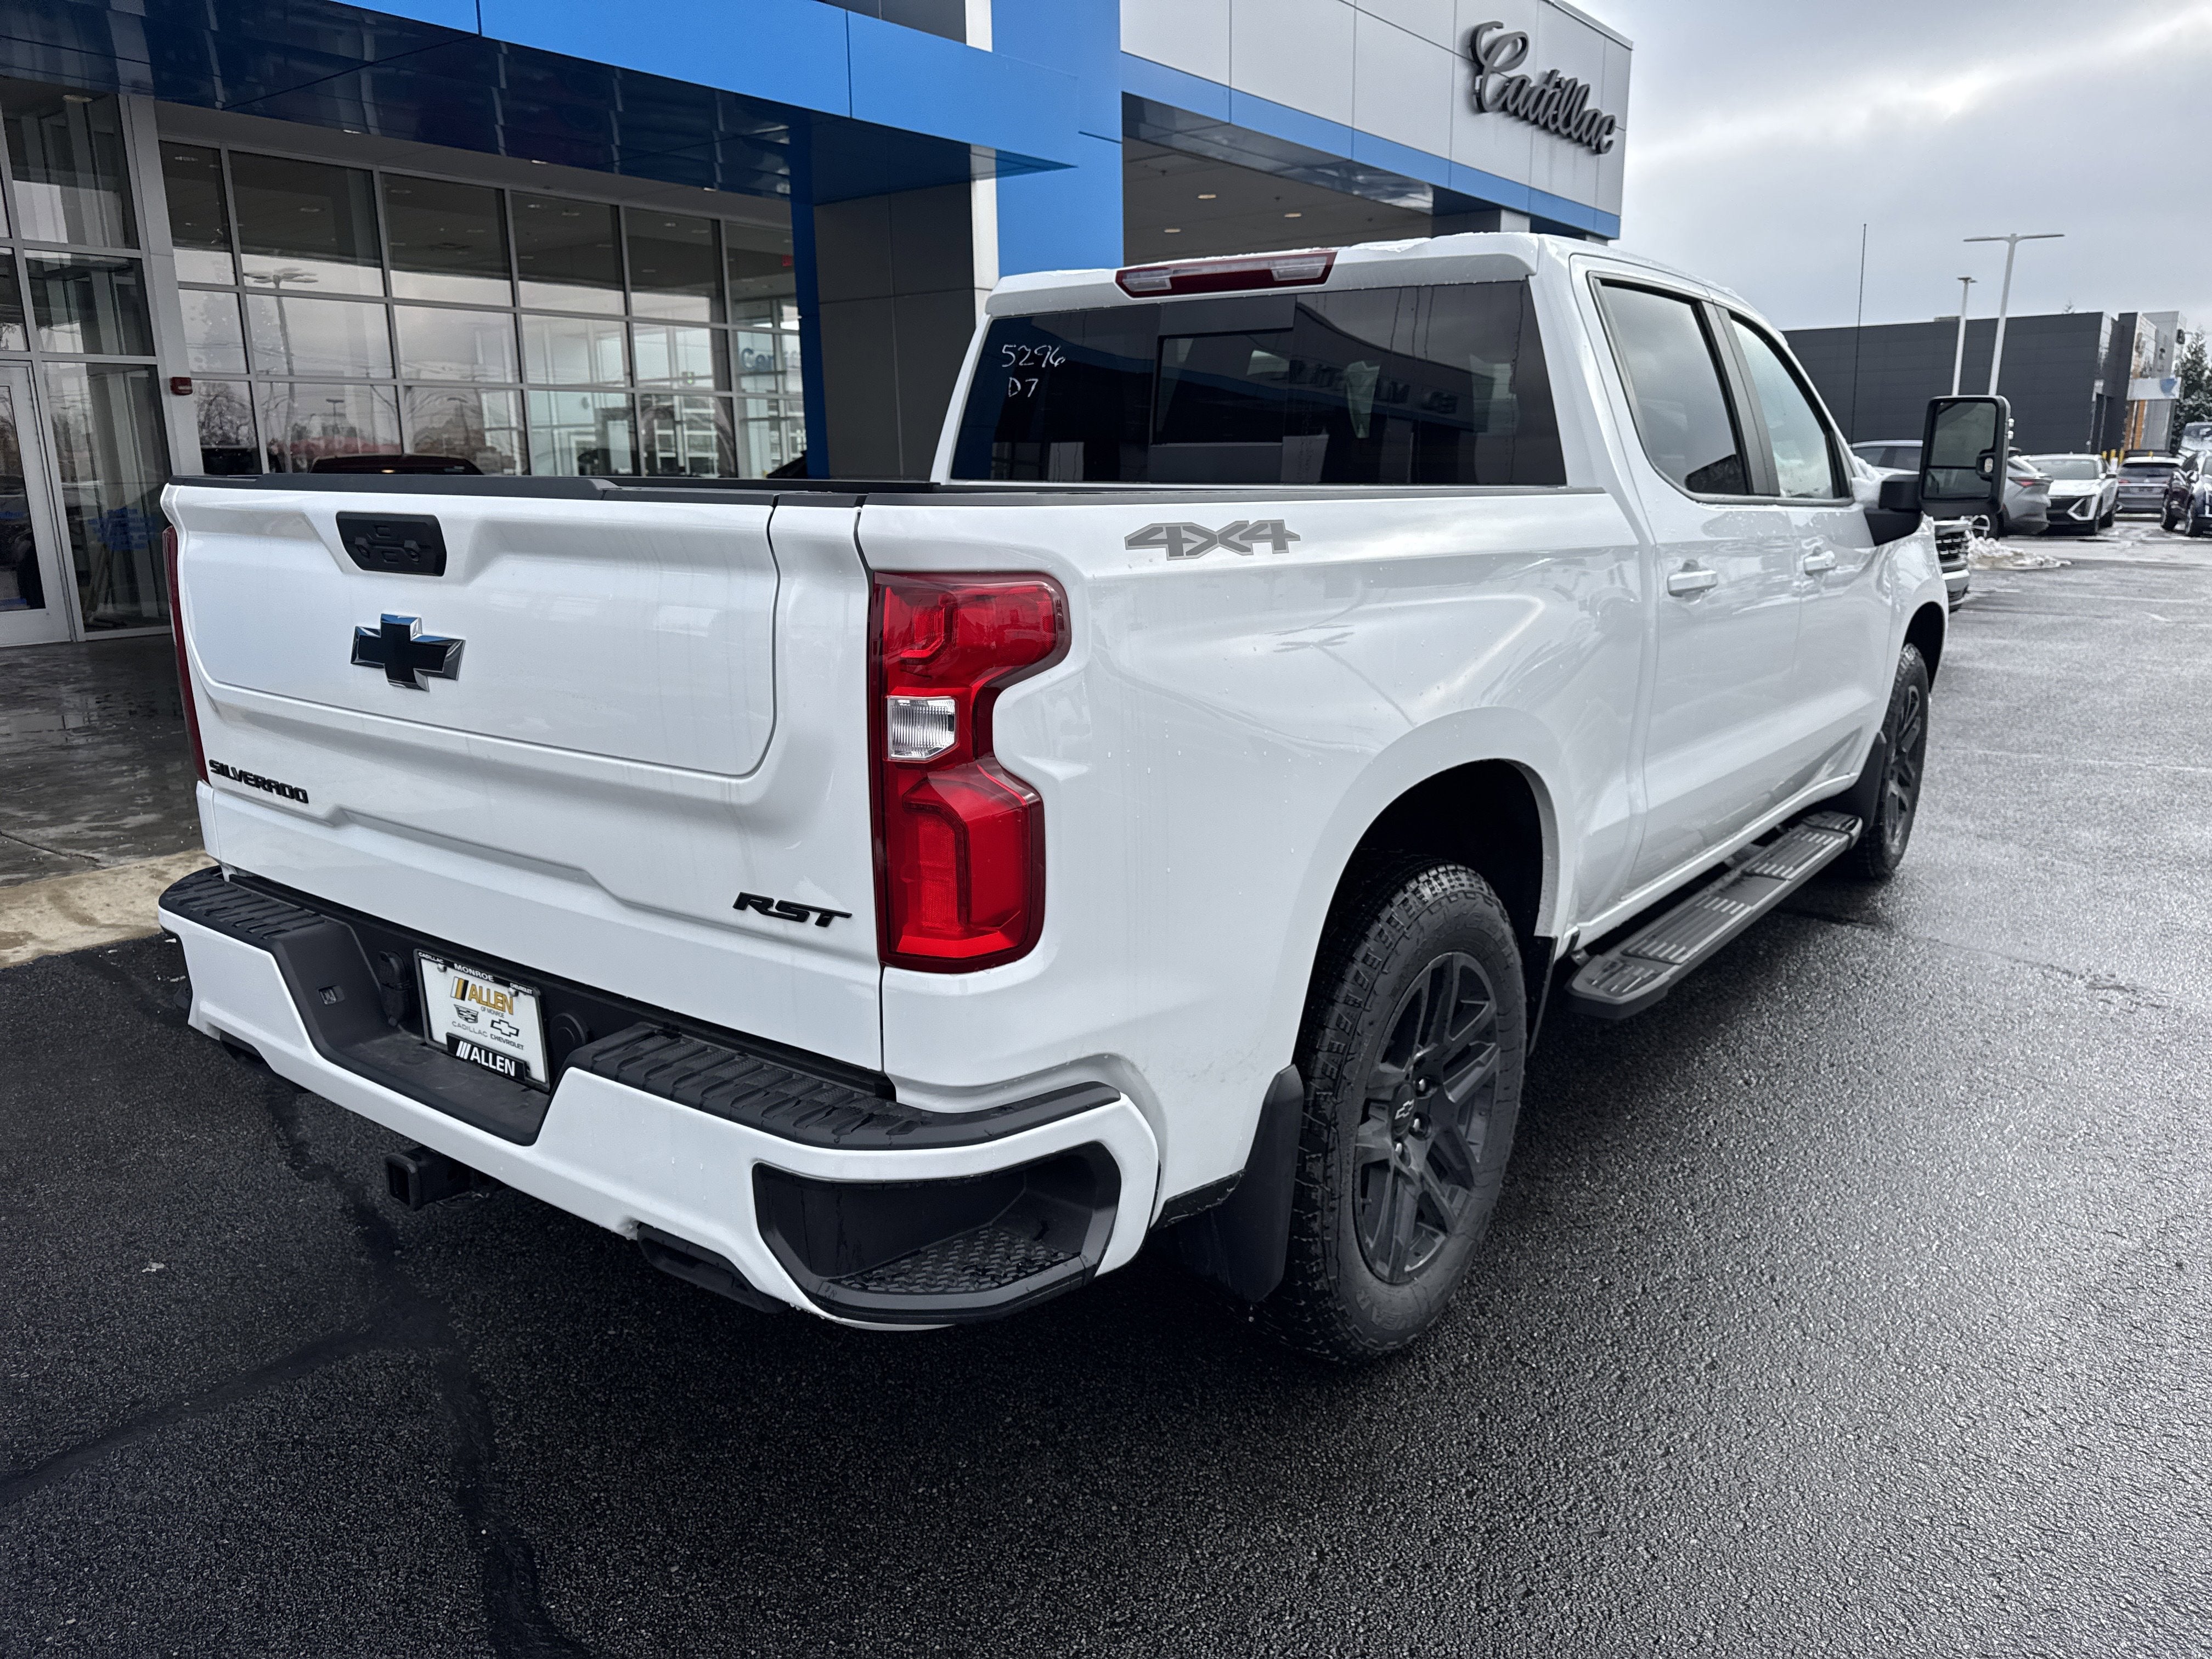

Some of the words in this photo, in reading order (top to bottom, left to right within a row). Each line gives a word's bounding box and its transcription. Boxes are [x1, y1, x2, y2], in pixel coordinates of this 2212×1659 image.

[1471, 21, 1615, 154] Cadillac
[1002, 344, 1065, 368] 5296
[209, 759, 309, 804] SILVERADO
[732, 891, 852, 928] RST
[418, 952, 444, 964] CADILLAC
[454, 963, 494, 982] MONROE
[510, 983, 533, 995] CHEVROLET
[468, 983, 514, 1015] ALLEN
[488, 1008, 505, 1018] MONROE
[452, 1020, 488, 1037] CADILLAC
[490, 1034, 524, 1050] CHEVROLET
[470, 1047, 515, 1076] ALLEN
